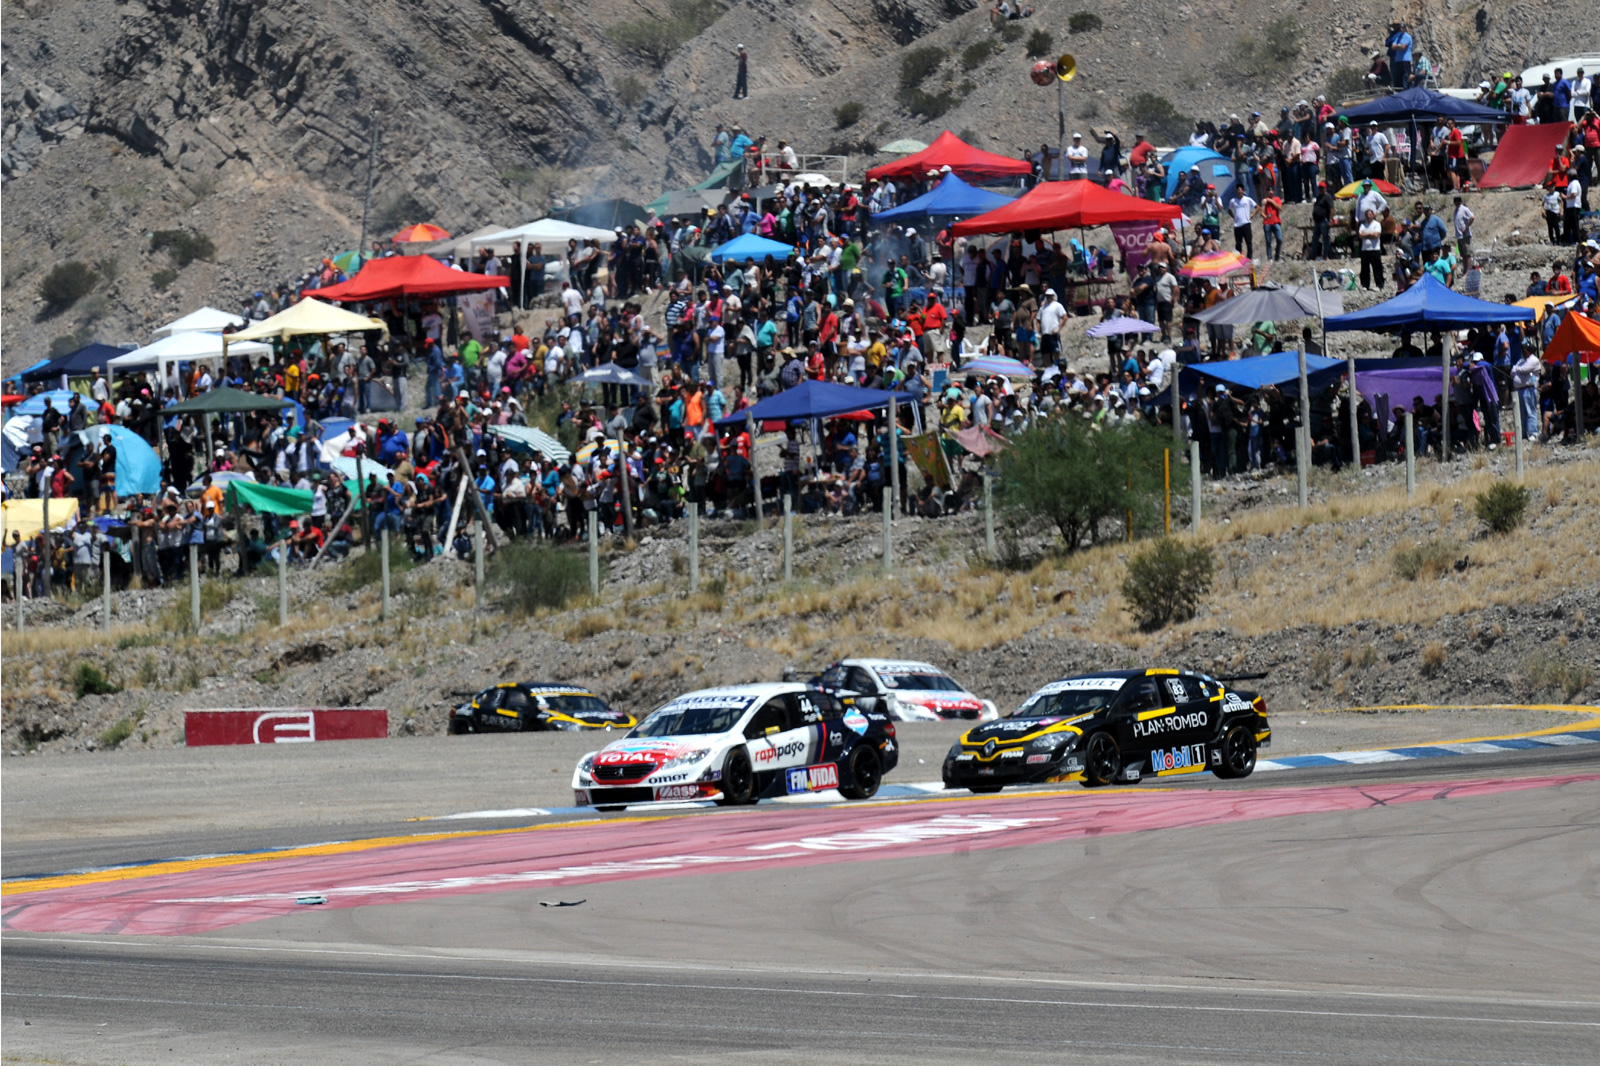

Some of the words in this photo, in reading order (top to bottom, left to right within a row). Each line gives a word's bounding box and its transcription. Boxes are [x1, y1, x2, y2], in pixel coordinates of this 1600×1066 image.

[1172, 684, 1184, 696] 83
[801, 698, 813, 713] 44
[600, 753, 656, 764] TOTAL
[755, 741, 805, 764] rapipago
[1151, 745, 1192, 771] Mobil
[648, 772, 689, 785] omer
[791, 771, 809, 790] FM
